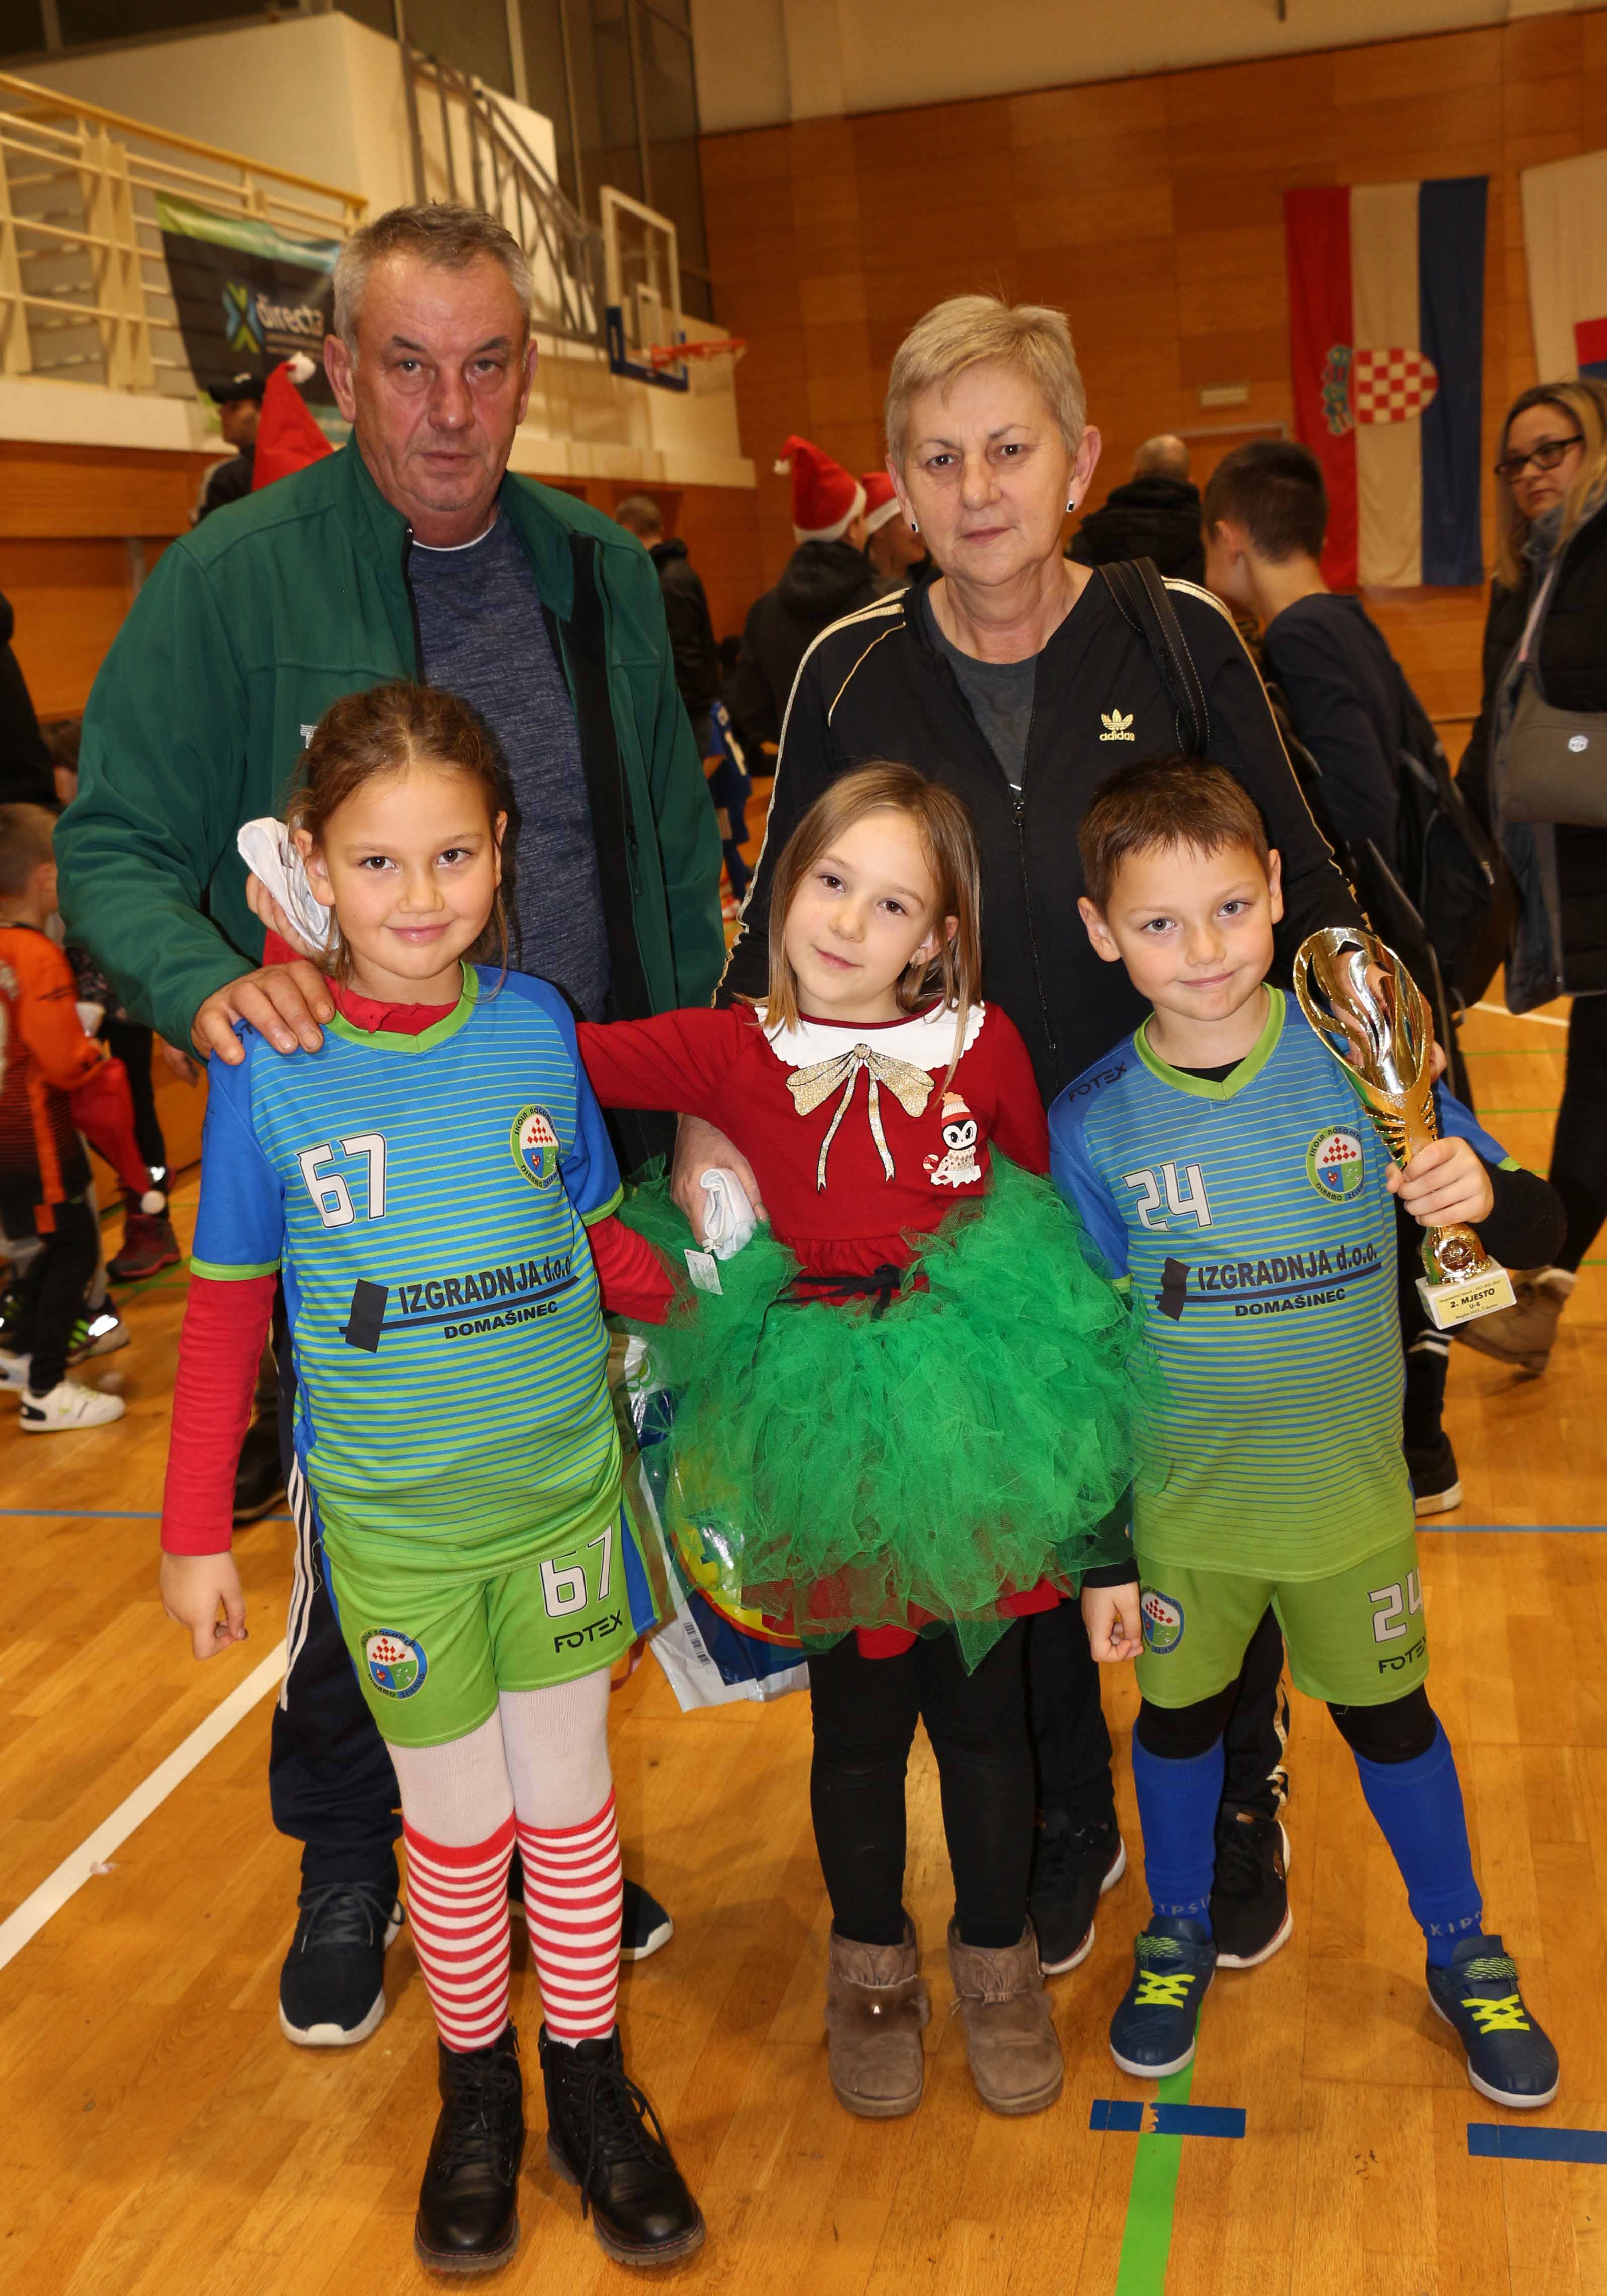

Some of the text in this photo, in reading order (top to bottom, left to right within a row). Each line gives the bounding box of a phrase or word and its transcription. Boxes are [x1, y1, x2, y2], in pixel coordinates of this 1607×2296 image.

[1099, 730, 1135, 741] adidas
[1069, 1061, 1127, 1103] FOTEX
[294, 1132, 387, 1229] 67
[1121, 1161, 1212, 1232] 24
[399, 1260, 542, 1315] IZGRADNJA
[1198, 1243, 1378, 1292] IZGRADNJA d.o.o.
[1235, 1288, 1346, 1317] DOMAŠINEC
[1461, 1288, 1495, 1305] MJESTO
[444, 1301, 558, 1340] DOMAŠINEC
[539, 1523, 613, 1618] 67
[1367, 1567, 1423, 1643] 24
[554, 1609, 623, 1653] FOTEX
